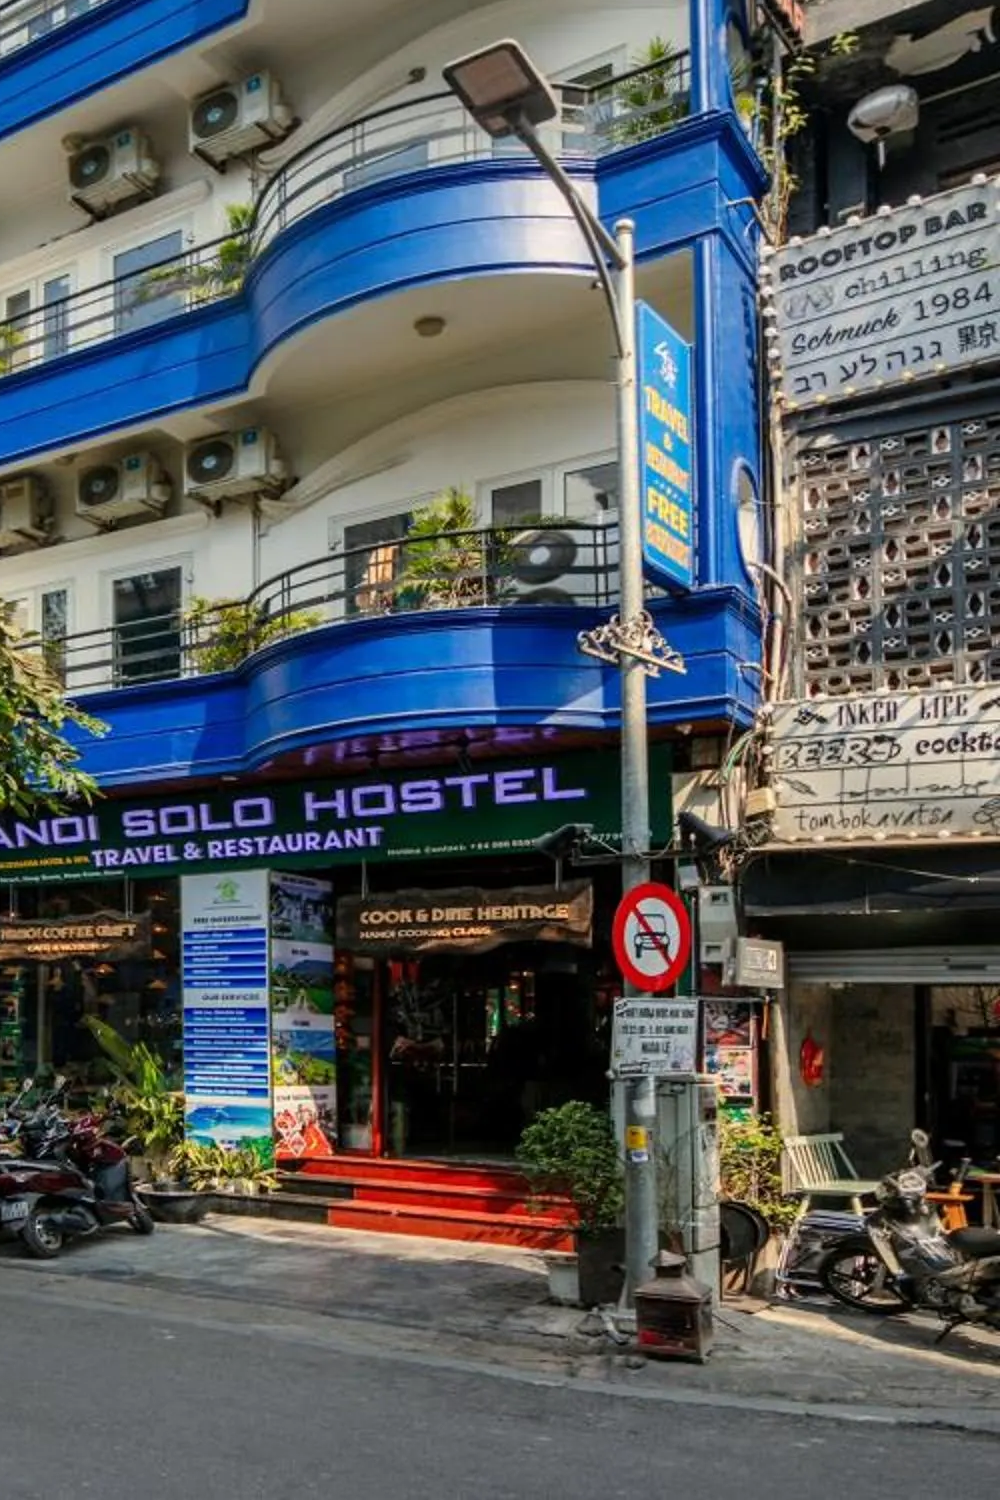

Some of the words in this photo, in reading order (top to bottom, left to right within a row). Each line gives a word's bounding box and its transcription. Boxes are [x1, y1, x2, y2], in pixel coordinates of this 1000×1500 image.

[779, 223, 917, 283] ROOFTOP
[924, 201, 987, 237] BAR
[845, 246, 990, 300] chilling
[791, 307, 901, 355] Schmuck
[913, 281, 994, 321] 1984
[645, 385, 689, 445] TRAVEL
[647, 486, 689, 537] FREE
[837, 700, 898, 727] INKED
[920, 694, 968, 721] LIFE
[122, 796, 275, 839] SOLO
[304, 766, 587, 822] HOSTEL
[91, 844, 181, 868] TRAVEL
[183, 842, 201, 861] &
[207, 826, 385, 859] RESTAURANT
[43, 924, 95, 940] COFFEE
[360, 908, 411, 925] COOK
[415, 907, 430, 924] &
[432, 906, 474, 923] DINE
[478, 903, 570, 921] HERITAGE
[398, 927, 451, 939] COOKING
